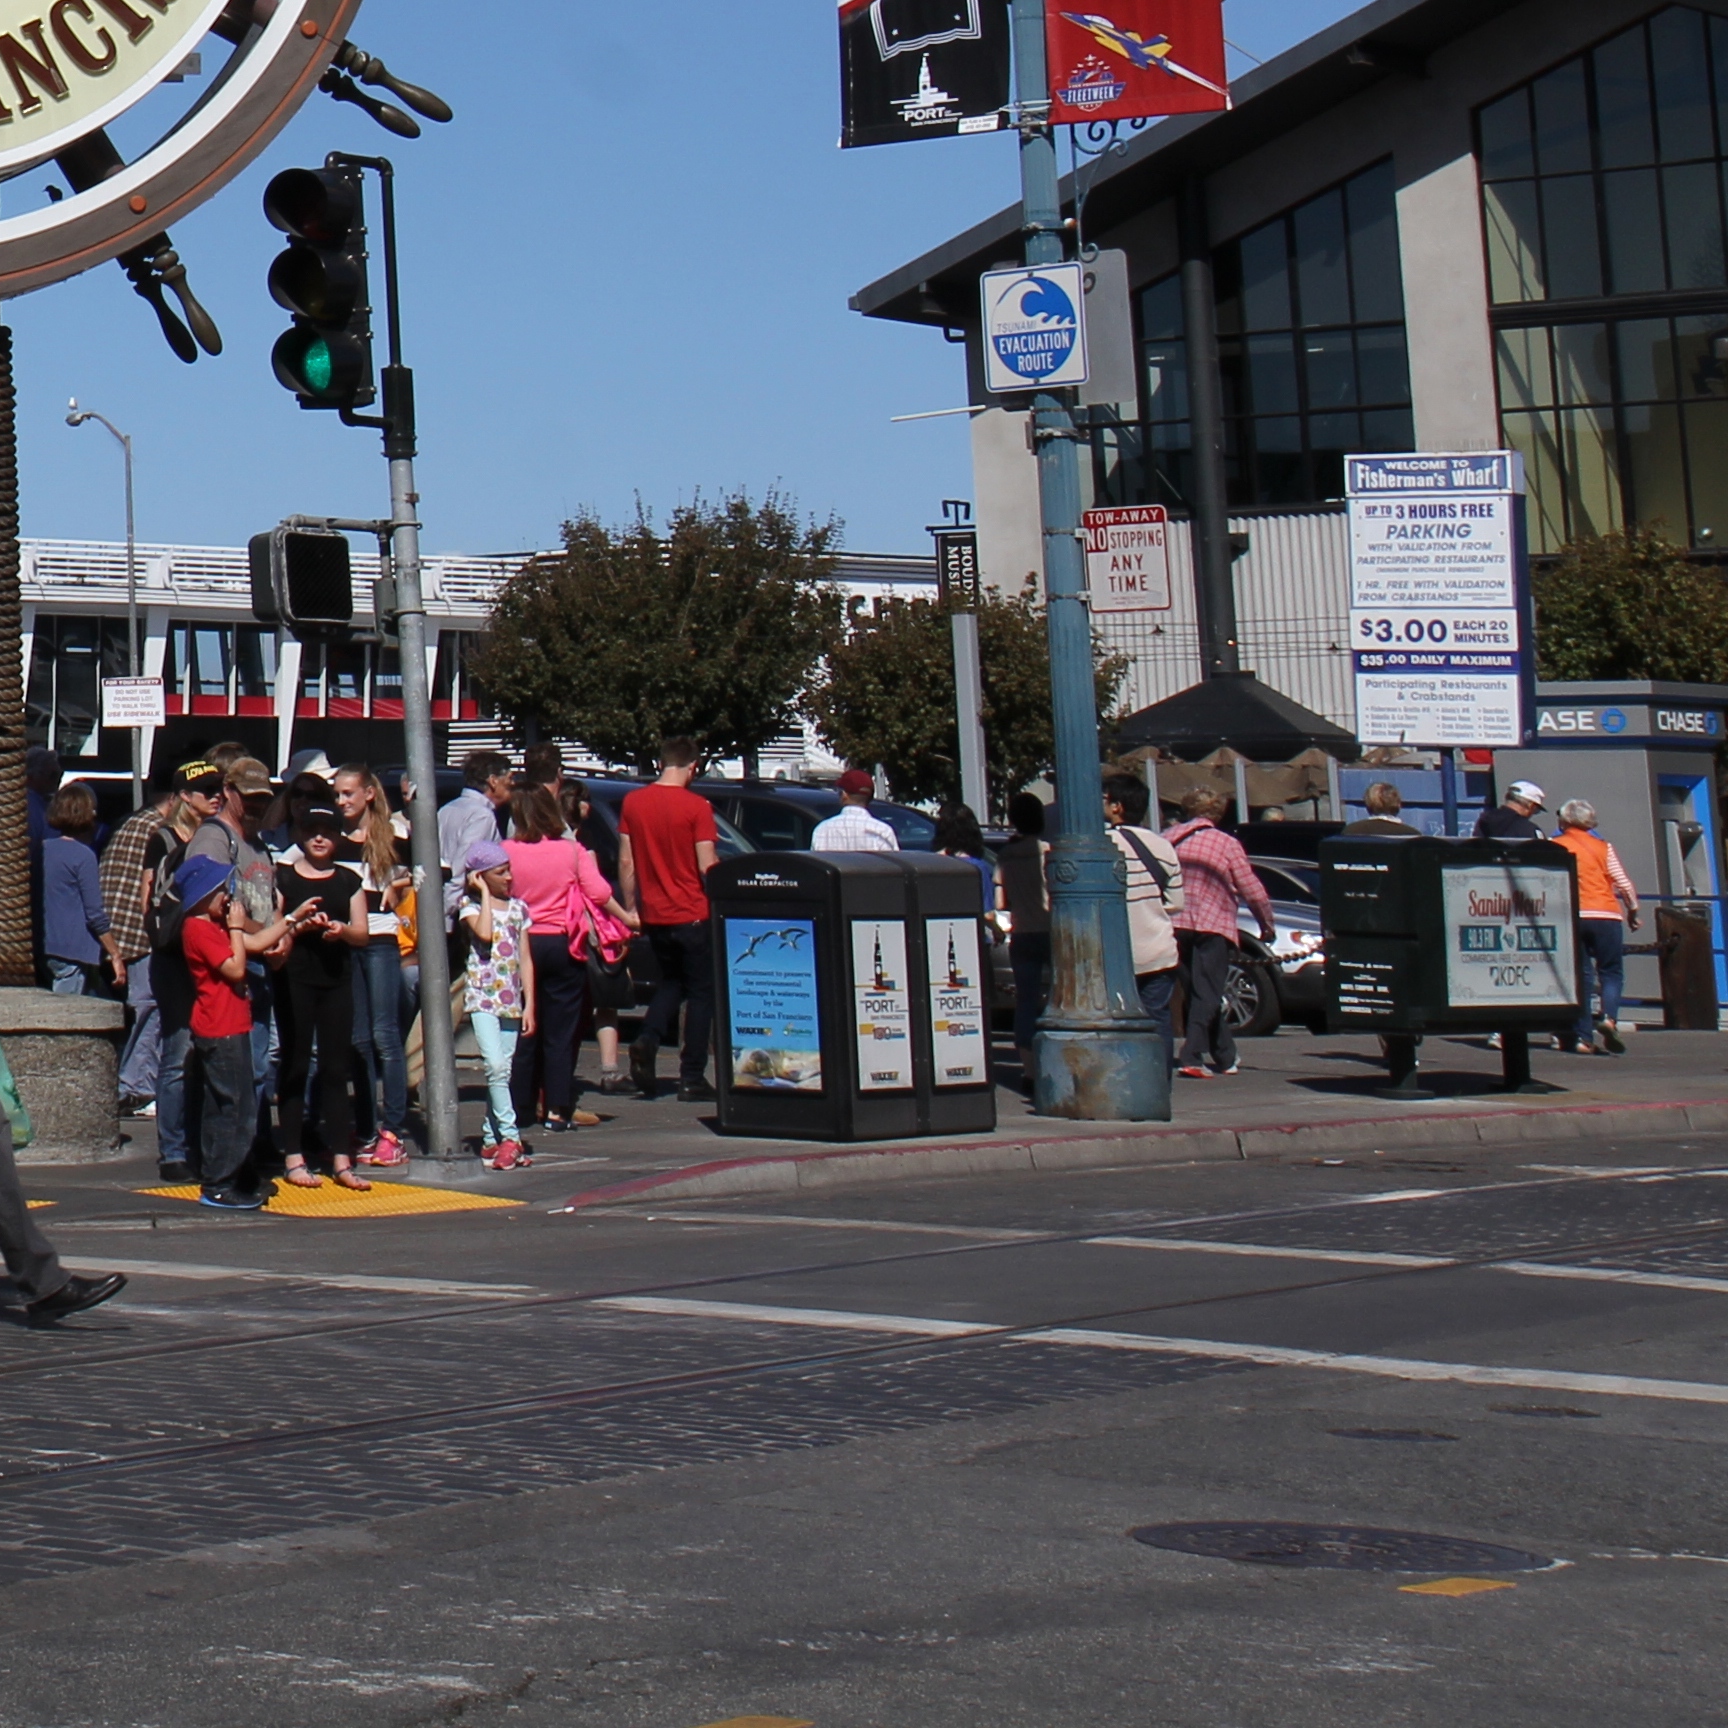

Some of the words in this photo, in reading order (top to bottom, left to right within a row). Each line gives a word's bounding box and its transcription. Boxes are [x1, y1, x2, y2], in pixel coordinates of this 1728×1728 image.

[904, 106, 945, 122] PORT
[997, 320, 1037, 333] TSUNAMI
[999, 331, 1069, 354] EVACUATION
[1017, 353, 1055, 372] ROUTE
[1384, 460, 1447, 470] WELCOME
[1451, 459, 1469, 468] TO
[1356, 462, 1446, 488] Fisherman's
[1451, 459, 1499, 486] Wharf
[1088, 510, 1159, 525] TOW-AWAY
[1365, 505, 1378, 515] UP
[1380, 505, 1392, 515] TO
[1395, 504, 1405, 519] 3
[1408, 504, 1457, 518] HOURS
[1460, 503, 1494, 518] FREE
[1086, 527, 1107, 550] NO
[1110, 529, 1162, 549] STOPPING
[1386, 523, 1472, 539] PARKING
[1367, 543, 1392, 551] WITH
[1398, 542, 1457, 551] VALIDATION
[1460, 542, 1492, 550] FROM
[1111, 554, 1143, 572] ANY
[1356, 556, 1430, 565] PARTICIPATING
[1434, 555, 1506, 564] RESTAURANTS
[1108, 575, 1148, 592] TIME
[1386, 580, 1409, 589] FREE
[1414, 580, 1439, 588] WITH
[1444, 580, 1505, 588] VALIDATION
[1357, 593, 1386, 601] FROM
[1391, 592, 1460, 601] CRABSTANDS
[1360, 618, 1448, 643] $3.00
[1453, 621, 1486, 630] EACH
[1489, 621, 1508, 630] 20
[1453, 633, 1509, 643] MINUTES
[1360, 654, 1406, 666] $35.00
[1411, 655, 1445, 664] DAILY
[1450, 656, 1512, 666] MAXIMUM
[1365, 679, 1436, 691] Participating
[1441, 680, 1507, 690] Restaurants
[1397, 692, 1404, 700] &
[1411, 692, 1475, 701] Crabstands
[1657, 711, 1705, 733] CHASE
[1469, 890, 1511, 925] Sanity
[1499, 966, 1530, 986] KDFC
[865, 1000, 894, 1013] PORT
[940, 996, 968, 1010] PORT
[736, 1010, 752, 1018] Port
[753, 1011, 761, 1019] of
[762, 1011, 776, 1019] San
[778, 1012, 813, 1020] Francisco
